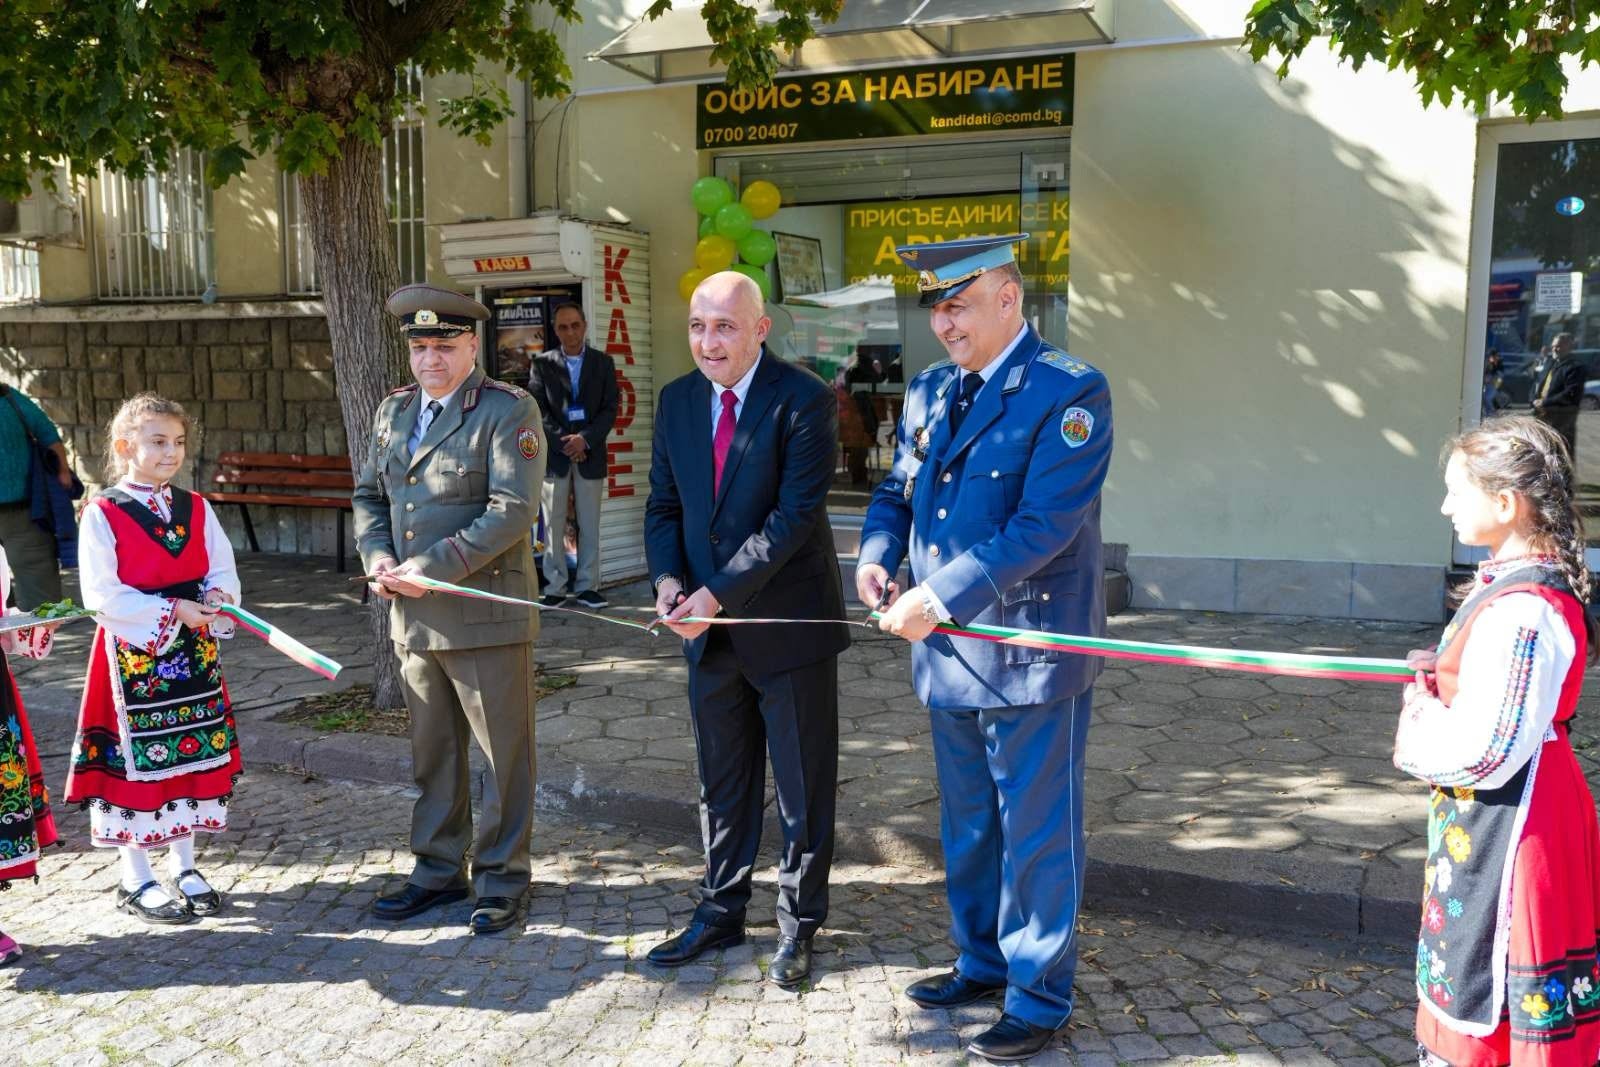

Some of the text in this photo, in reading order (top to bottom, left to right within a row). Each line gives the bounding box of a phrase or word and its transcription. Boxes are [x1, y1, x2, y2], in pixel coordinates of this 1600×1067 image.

[705, 62, 1064, 114] ОФИС ЗА НАБИРАНЕ
[930, 108, 1062, 128] kandidati@comd.bg
[704, 122, 799, 144] 0700 20407
[850, 203, 1013, 228] ПРИСЪЕДИНИ
[1018, 202, 1049, 222] СЕ
[481, 256, 526, 272] КАФЕ
[604, 244, 637, 498] КАФЕ
